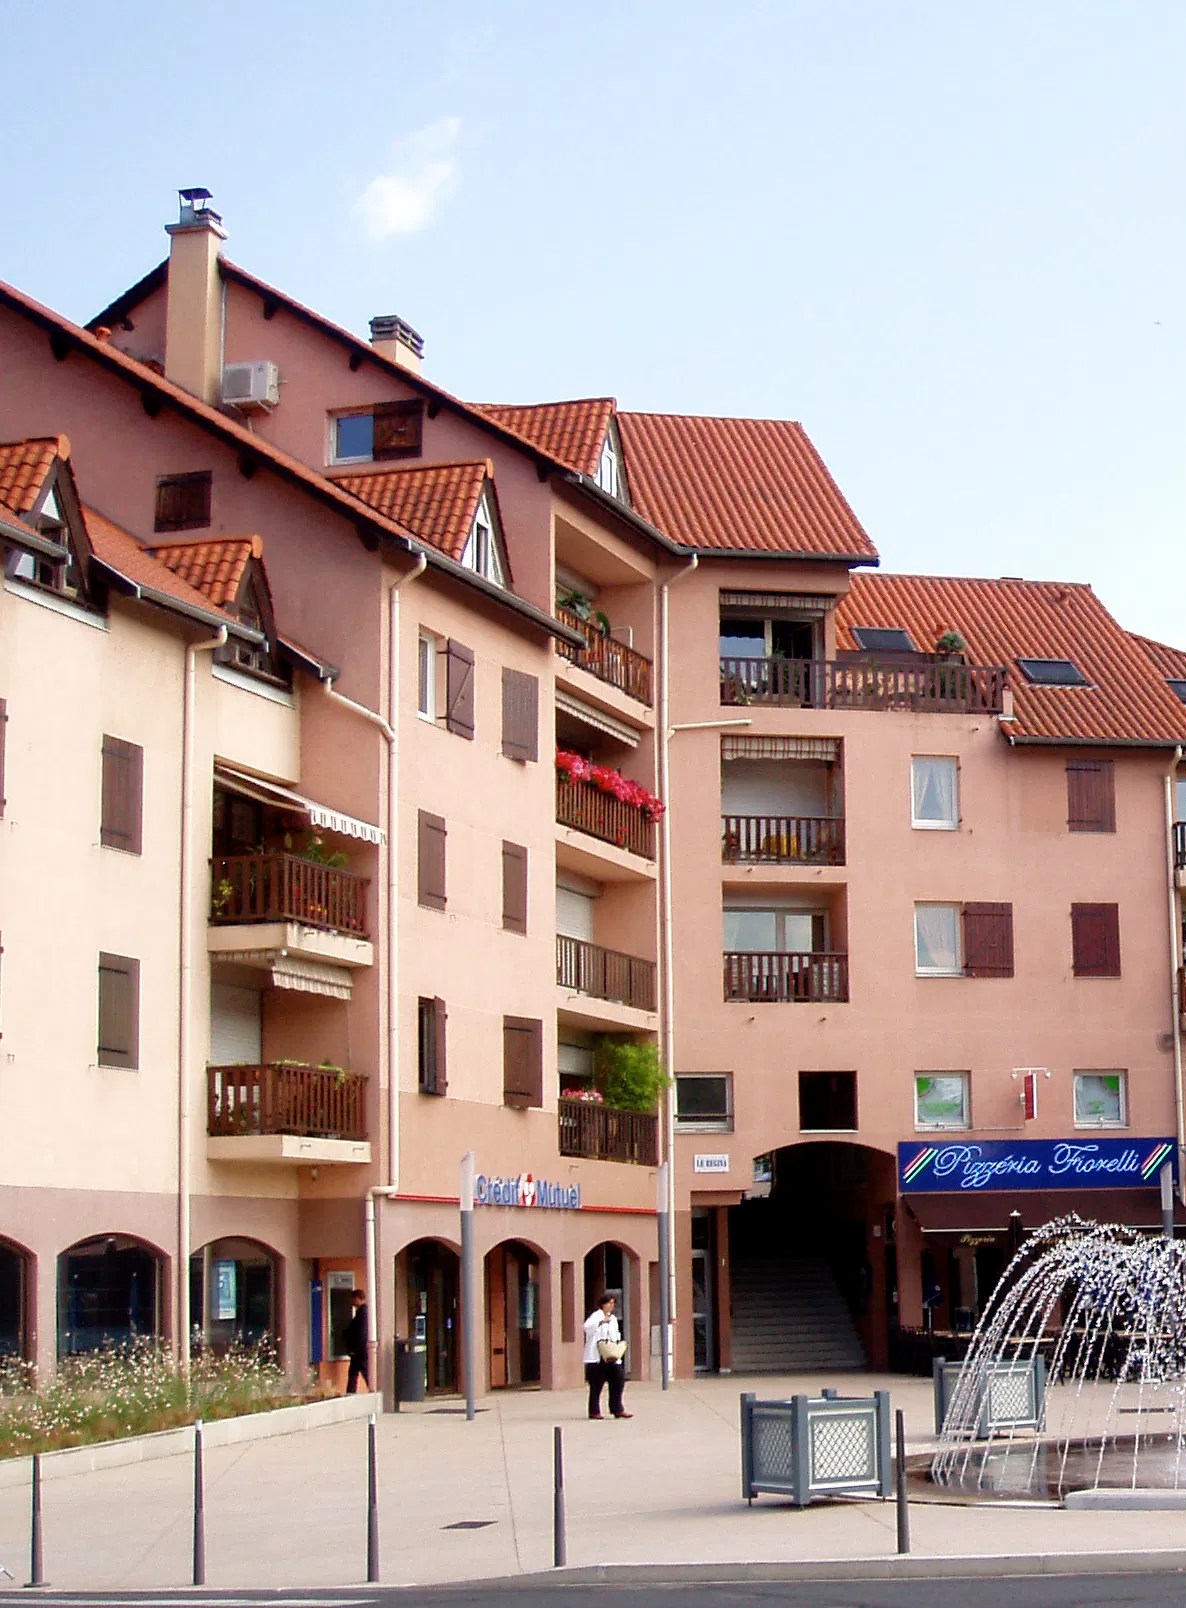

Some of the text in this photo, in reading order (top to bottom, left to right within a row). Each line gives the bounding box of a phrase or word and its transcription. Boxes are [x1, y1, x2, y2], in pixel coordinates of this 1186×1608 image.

[933, 1142, 1140, 1188] Pizzéria Fiorelli
[476, 1174, 581, 1209] Crédit Mutuel
